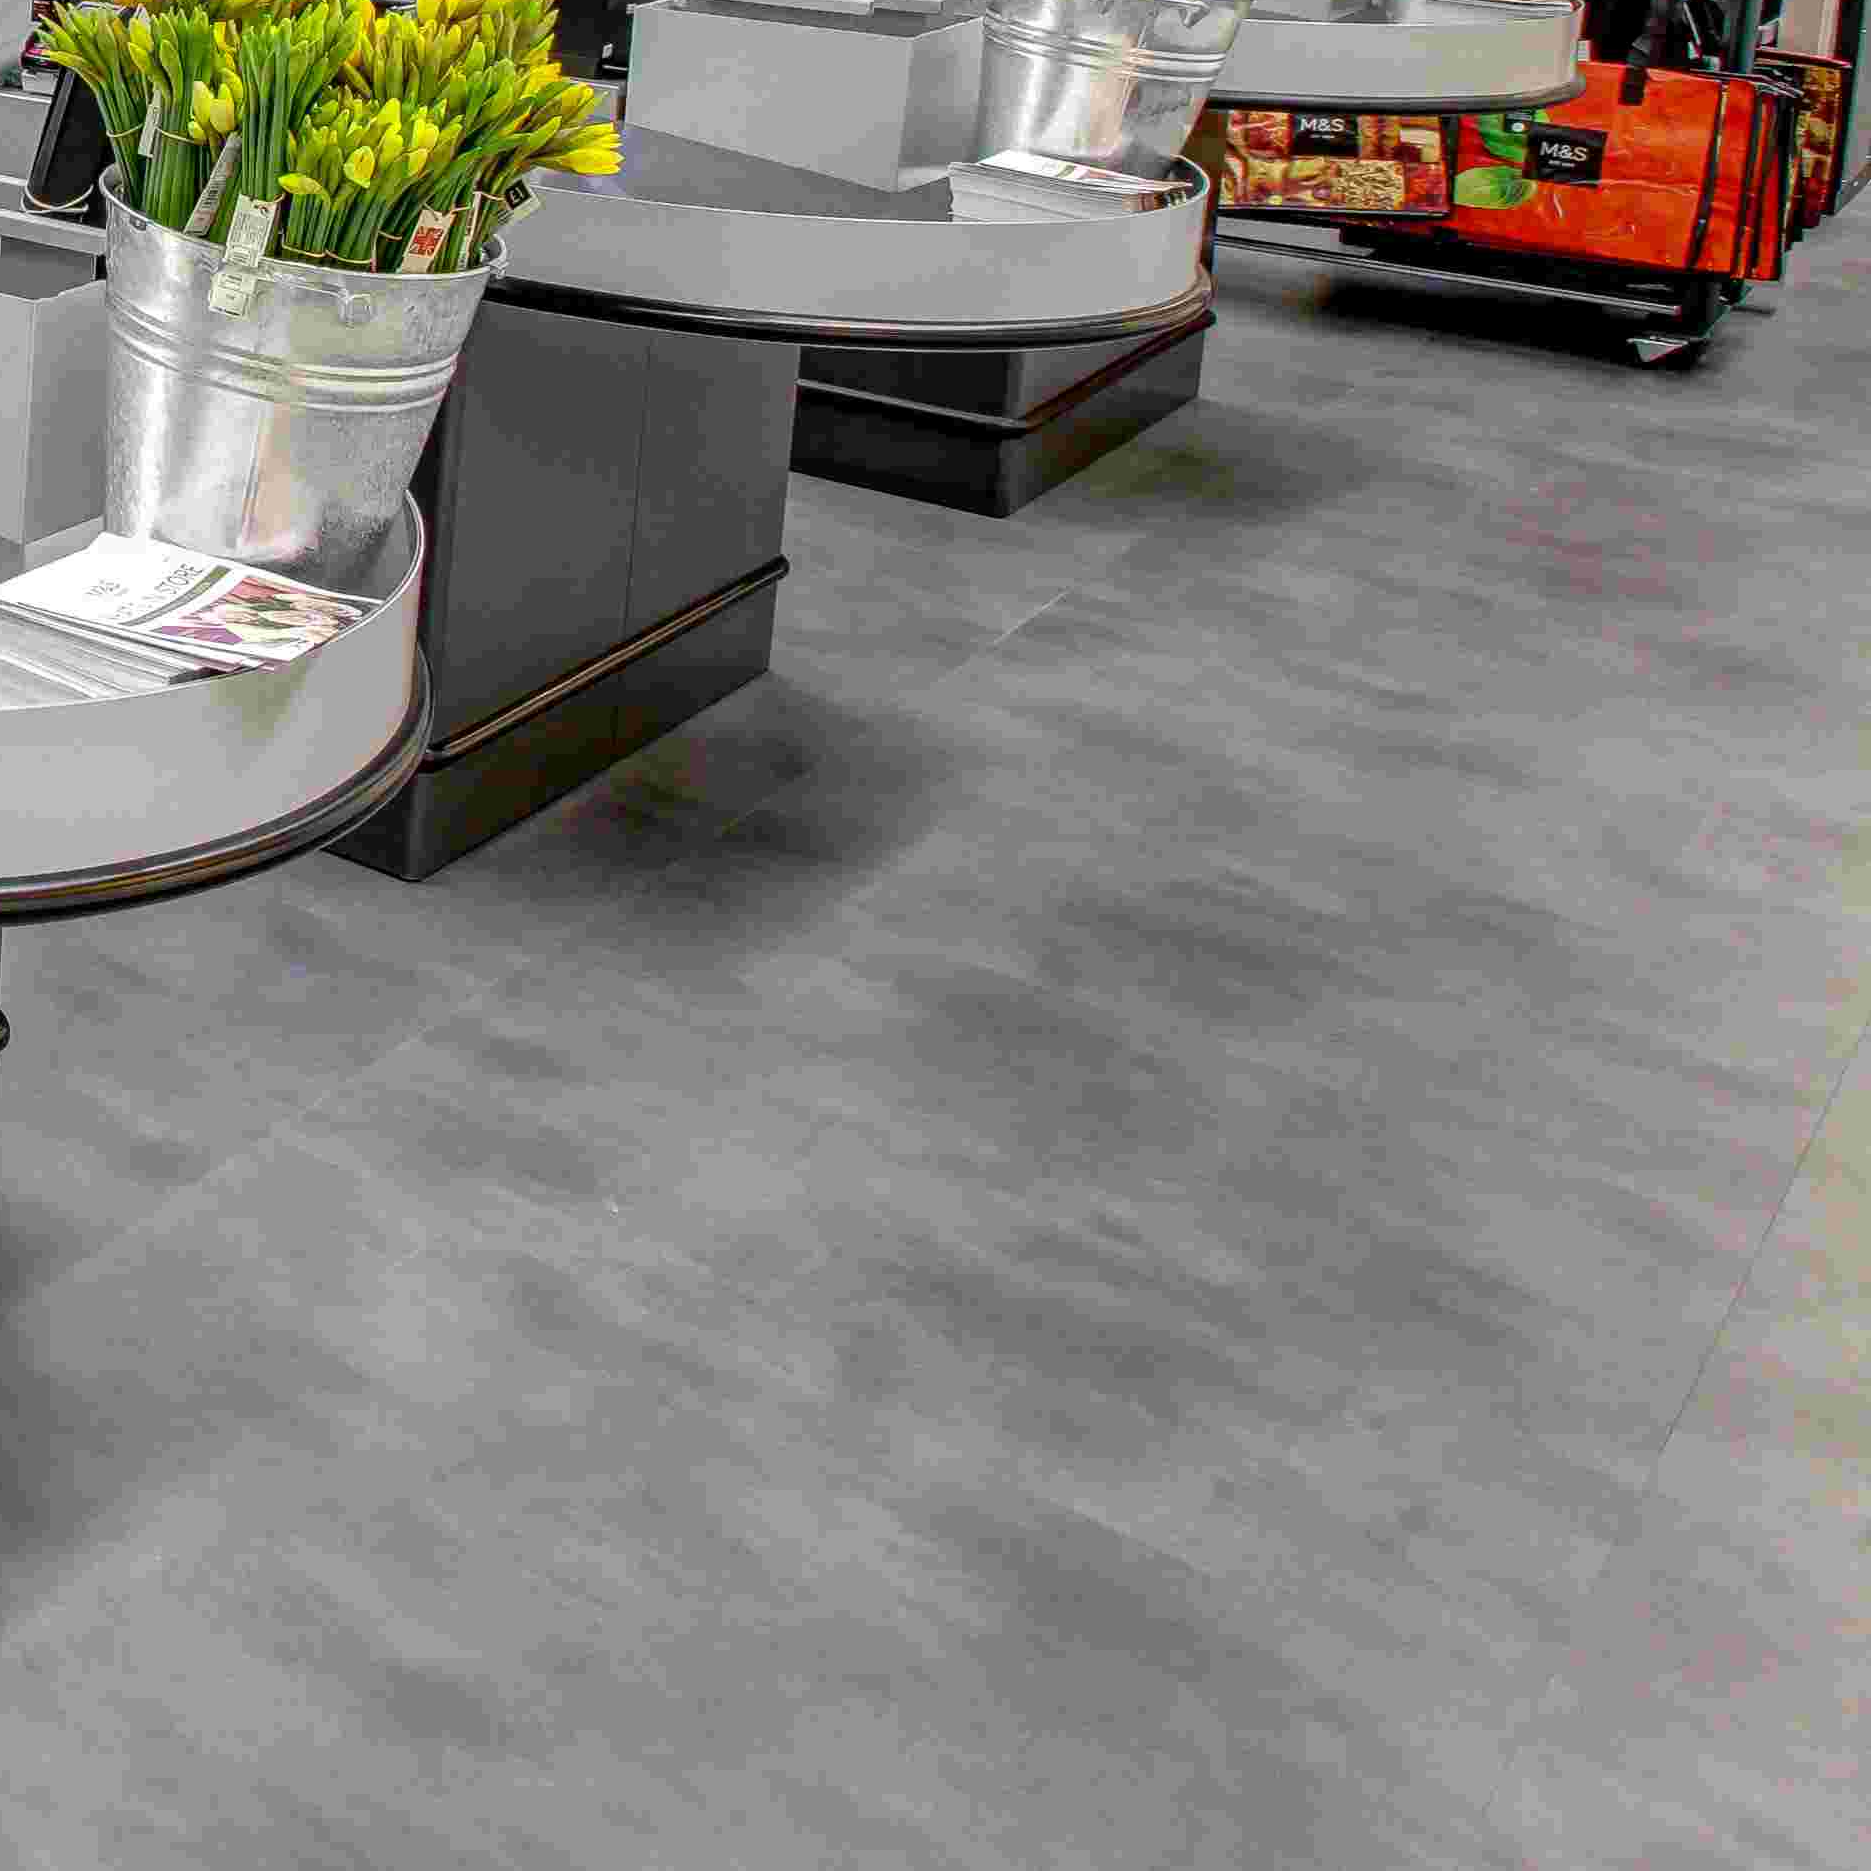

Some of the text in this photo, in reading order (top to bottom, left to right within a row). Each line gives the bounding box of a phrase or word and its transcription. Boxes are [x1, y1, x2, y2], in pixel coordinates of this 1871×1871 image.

[1300, 117, 1346, 131] M&S
[1539, 141, 1589, 162] M&S
[154, 563, 203, 594] STORE
